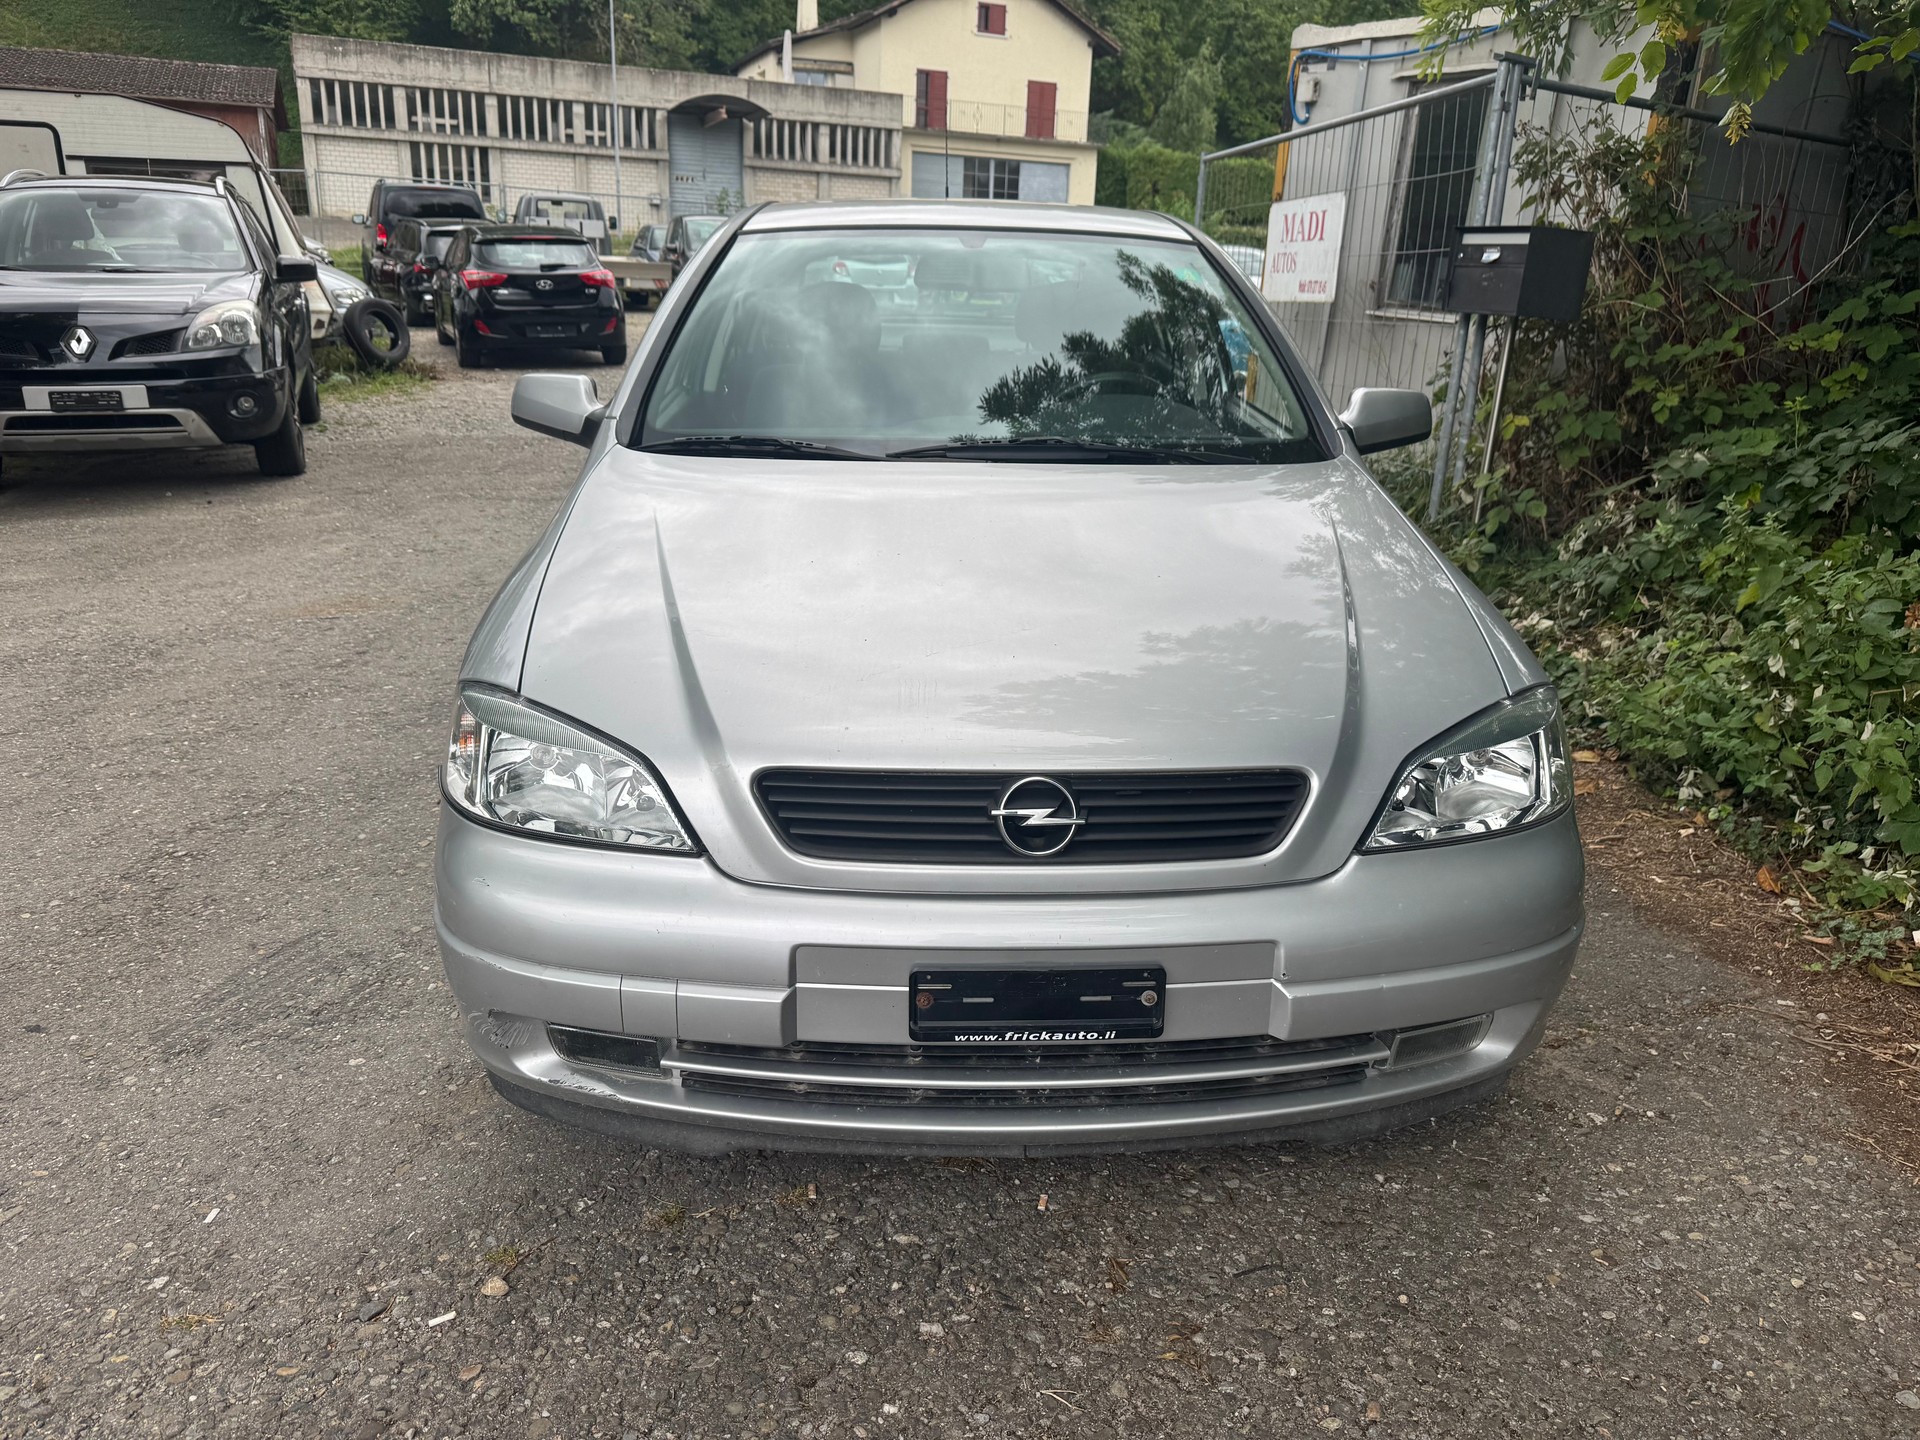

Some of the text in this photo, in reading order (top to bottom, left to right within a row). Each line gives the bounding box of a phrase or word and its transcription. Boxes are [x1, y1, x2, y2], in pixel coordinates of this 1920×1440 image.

[1280, 209, 1327, 243] MADI
[1270, 252, 1297, 274] AUTOS
[954, 1031, 1116, 1042] www.frickauto.li
